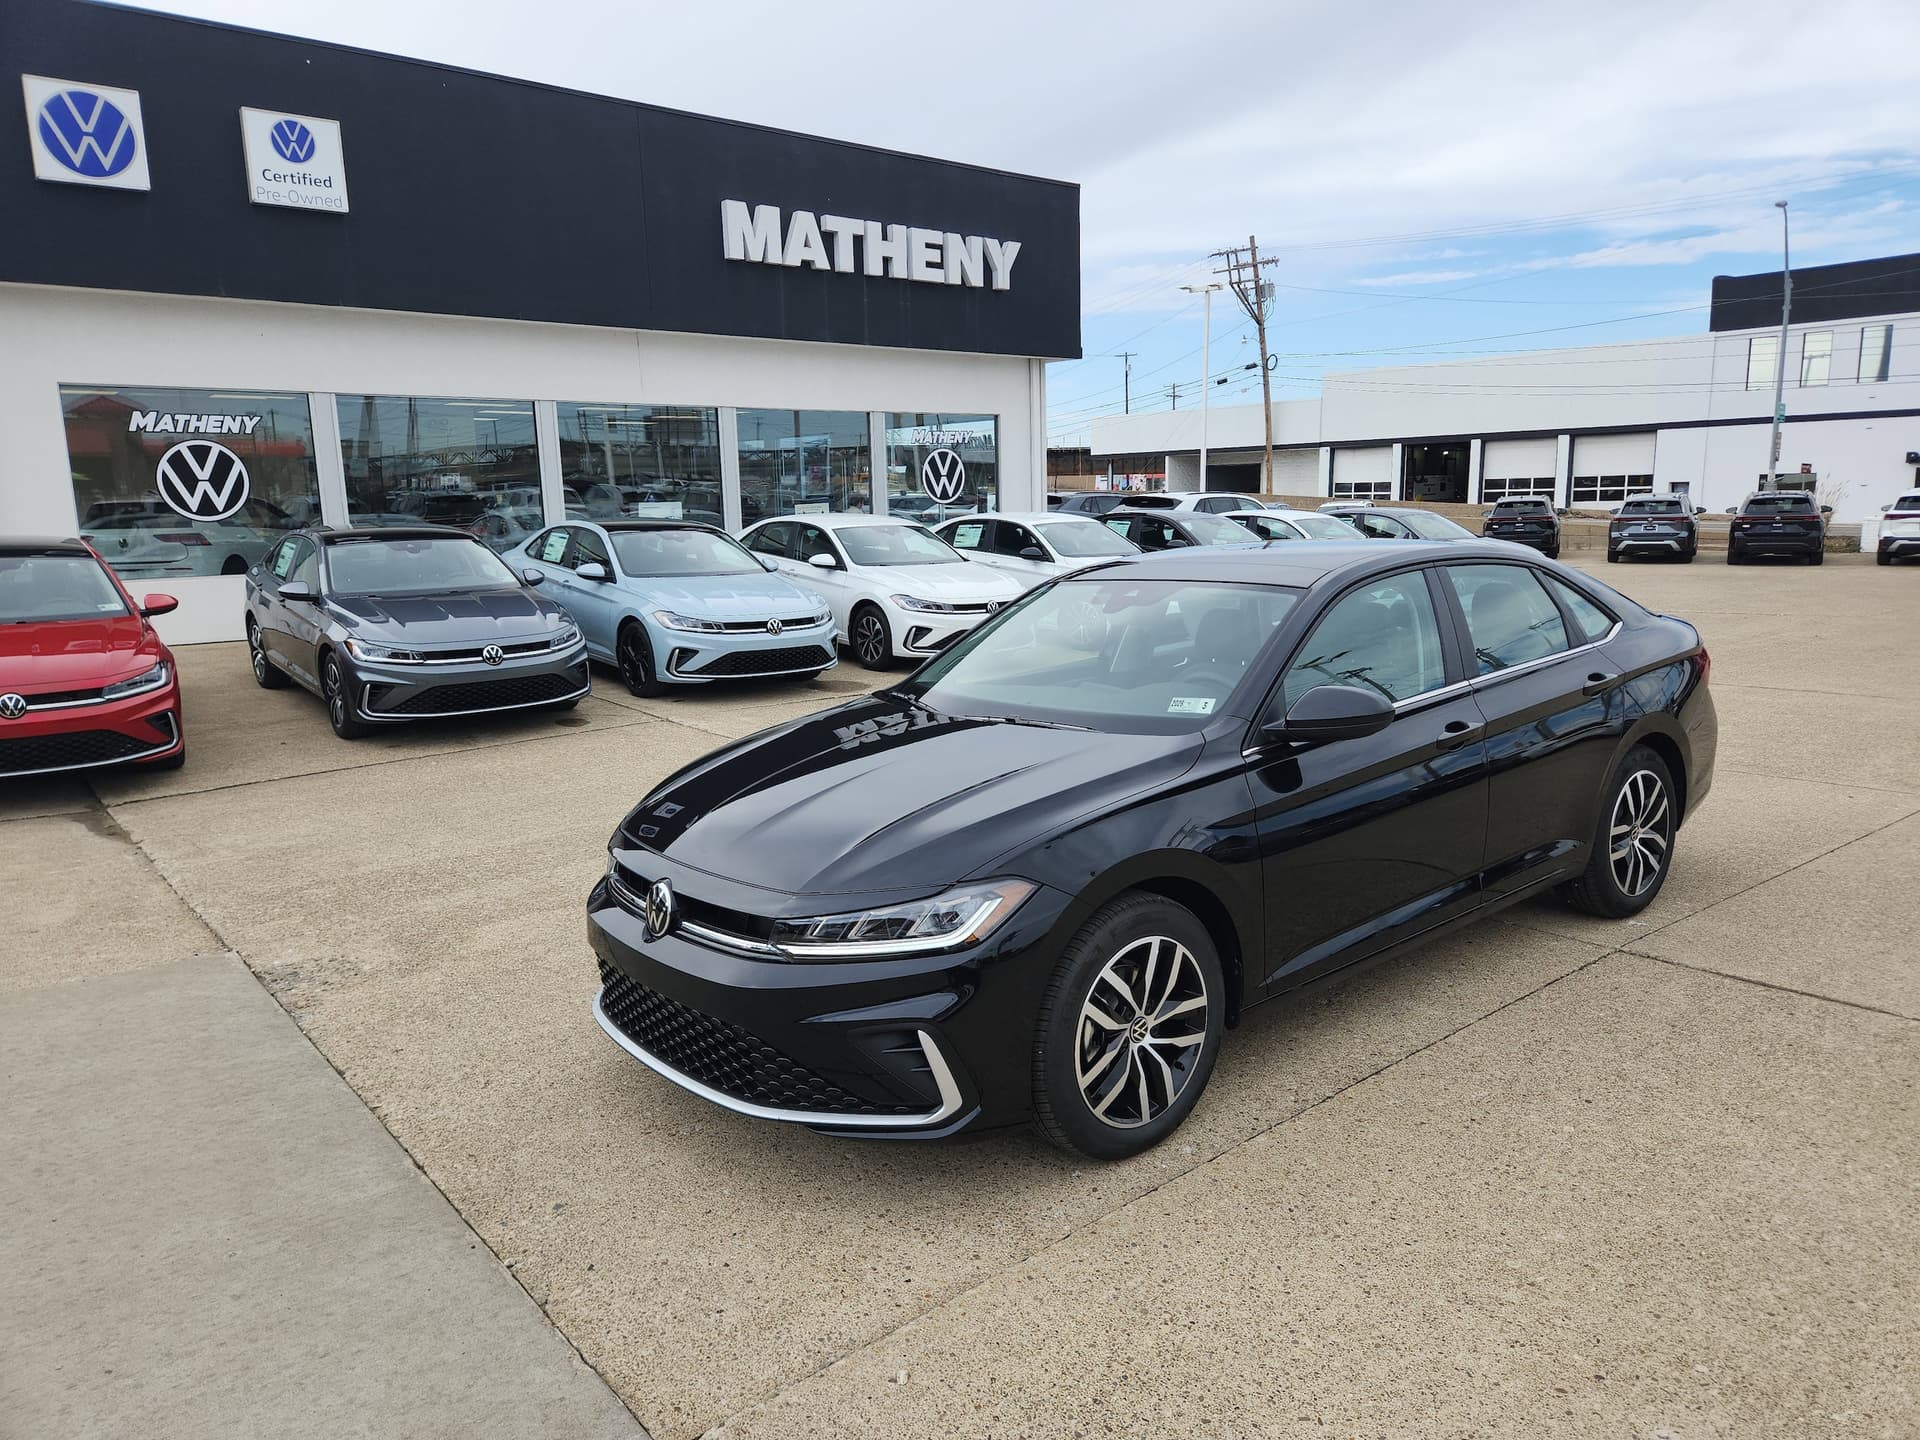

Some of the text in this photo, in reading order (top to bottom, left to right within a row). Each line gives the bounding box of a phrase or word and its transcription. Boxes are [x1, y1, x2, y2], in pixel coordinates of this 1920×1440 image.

[262, 168, 333, 189] Certified
[256, 186, 343, 209] Pre-Owned
[721, 199, 1022, 290] MATHENY
[128, 410, 261, 434] MATHENY
[912, 429, 973, 444] MATHENY
[156, 439, 250, 521] VW
[922, 448, 965, 504] VW
